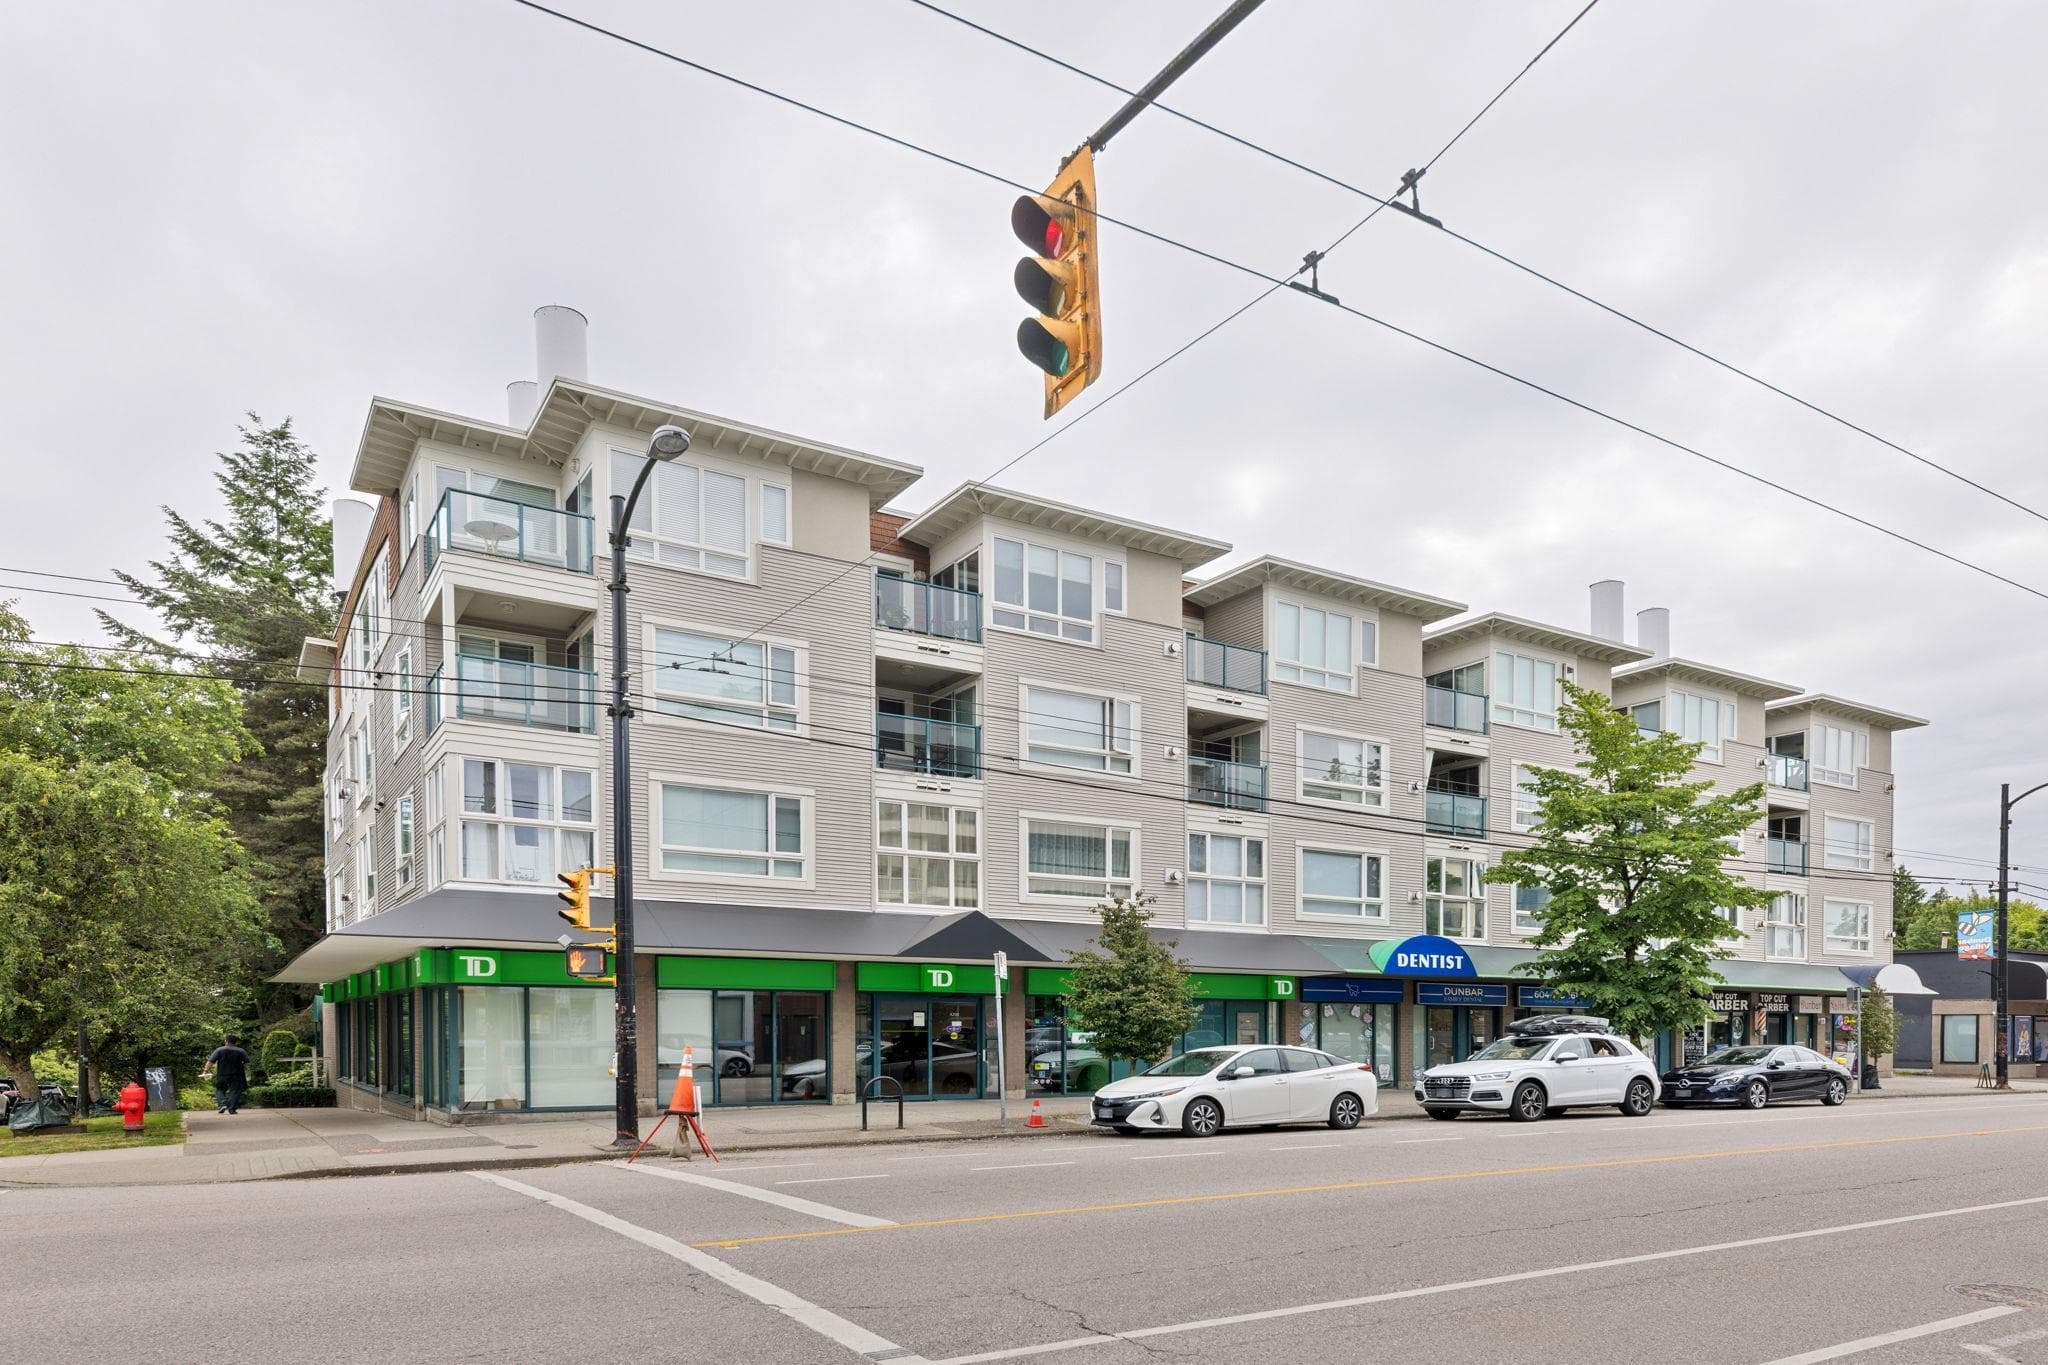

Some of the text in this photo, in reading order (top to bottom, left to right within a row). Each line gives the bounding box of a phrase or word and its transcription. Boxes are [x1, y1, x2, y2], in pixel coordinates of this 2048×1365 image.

[459, 955, 497, 977] TD
[1397, 953, 1464, 969] DENTIST
[927, 969, 953, 987] TD
[1273, 980, 1293, 995] TD
[1444, 987, 1484, 996] DUNBAR
[1704, 999, 1749, 1011] ARBER
[1760, 994, 1787, 1003] TOP CUT
